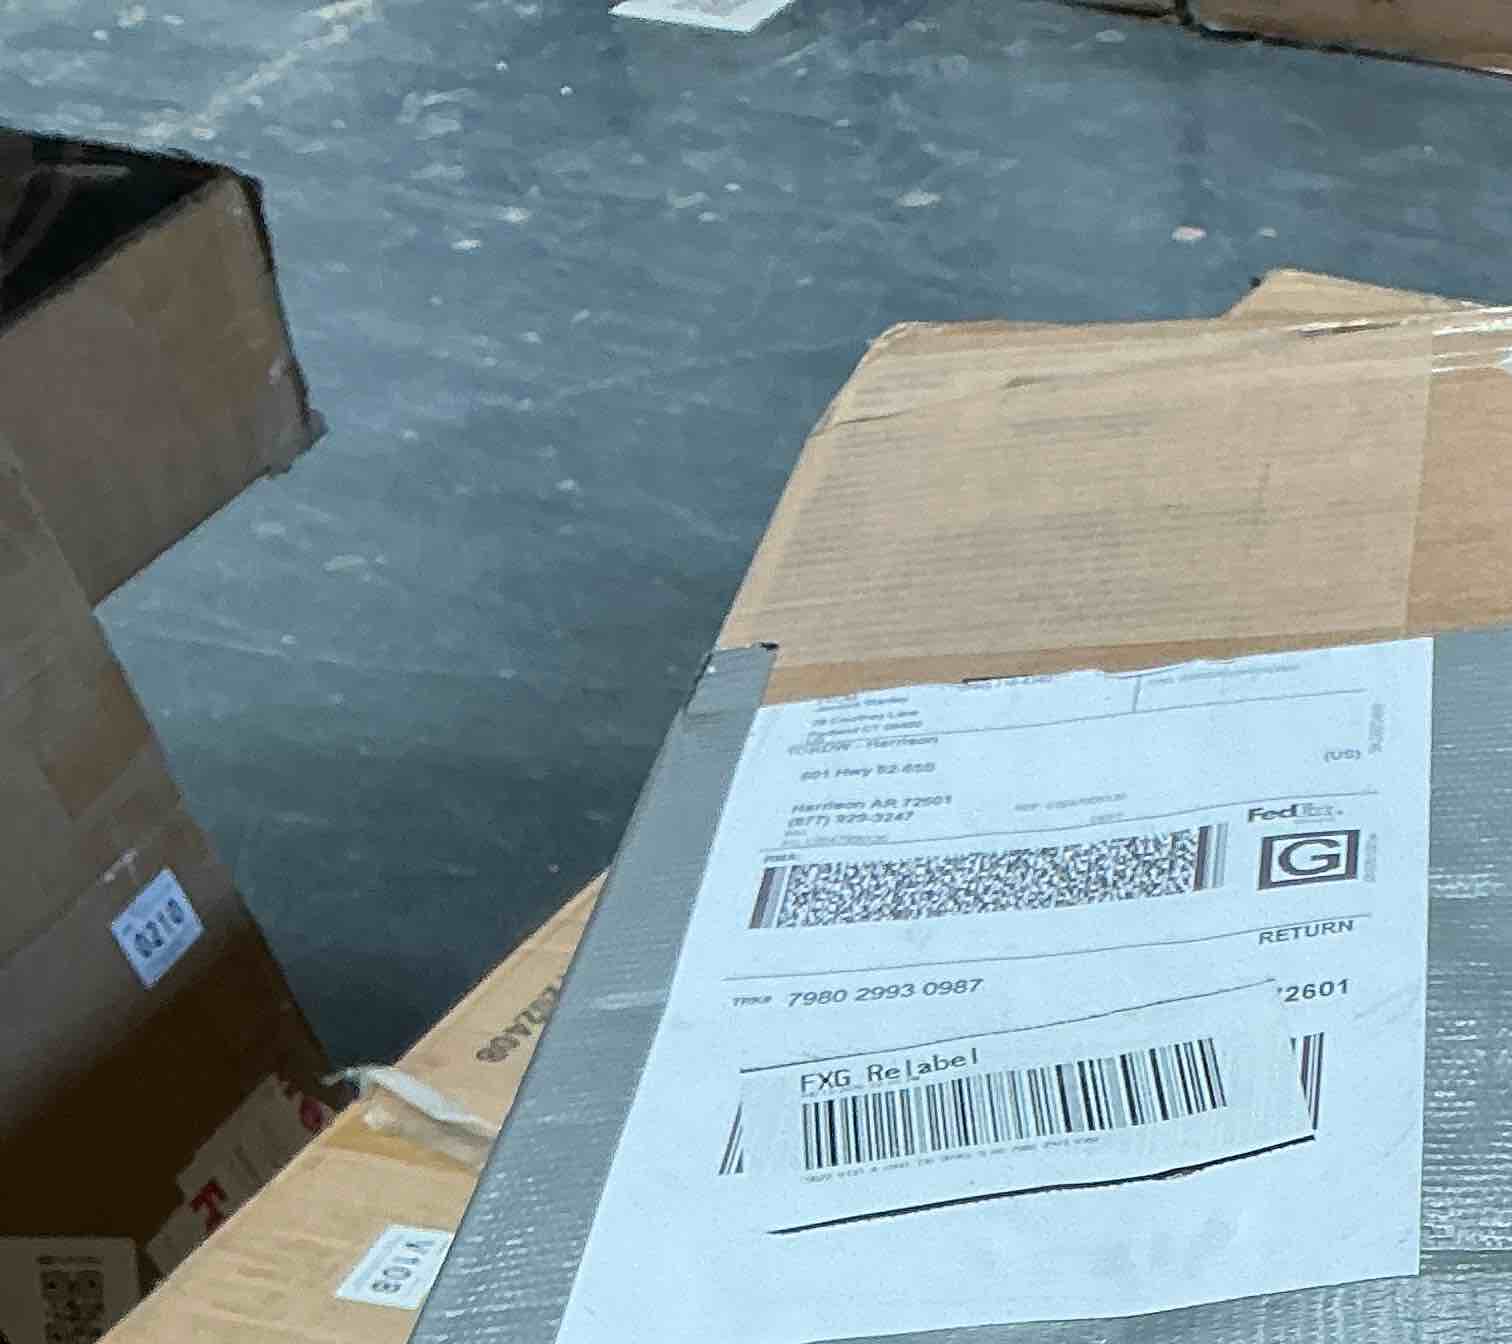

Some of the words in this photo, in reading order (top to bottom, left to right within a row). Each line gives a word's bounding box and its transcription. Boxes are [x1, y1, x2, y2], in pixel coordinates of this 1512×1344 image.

[1323, 748, 1362, 764] (US)
[1258, 917, 1356, 946] RETURN
[787, 988, 848, 1008] 7980
[855, 983, 916, 1003] 2993
[921, 977, 985, 997] 0987
[1277, 977, 1351, 1003] 2601
[801, 1068, 852, 1094] FXG
[866, 1047, 978, 1084] Relabel
